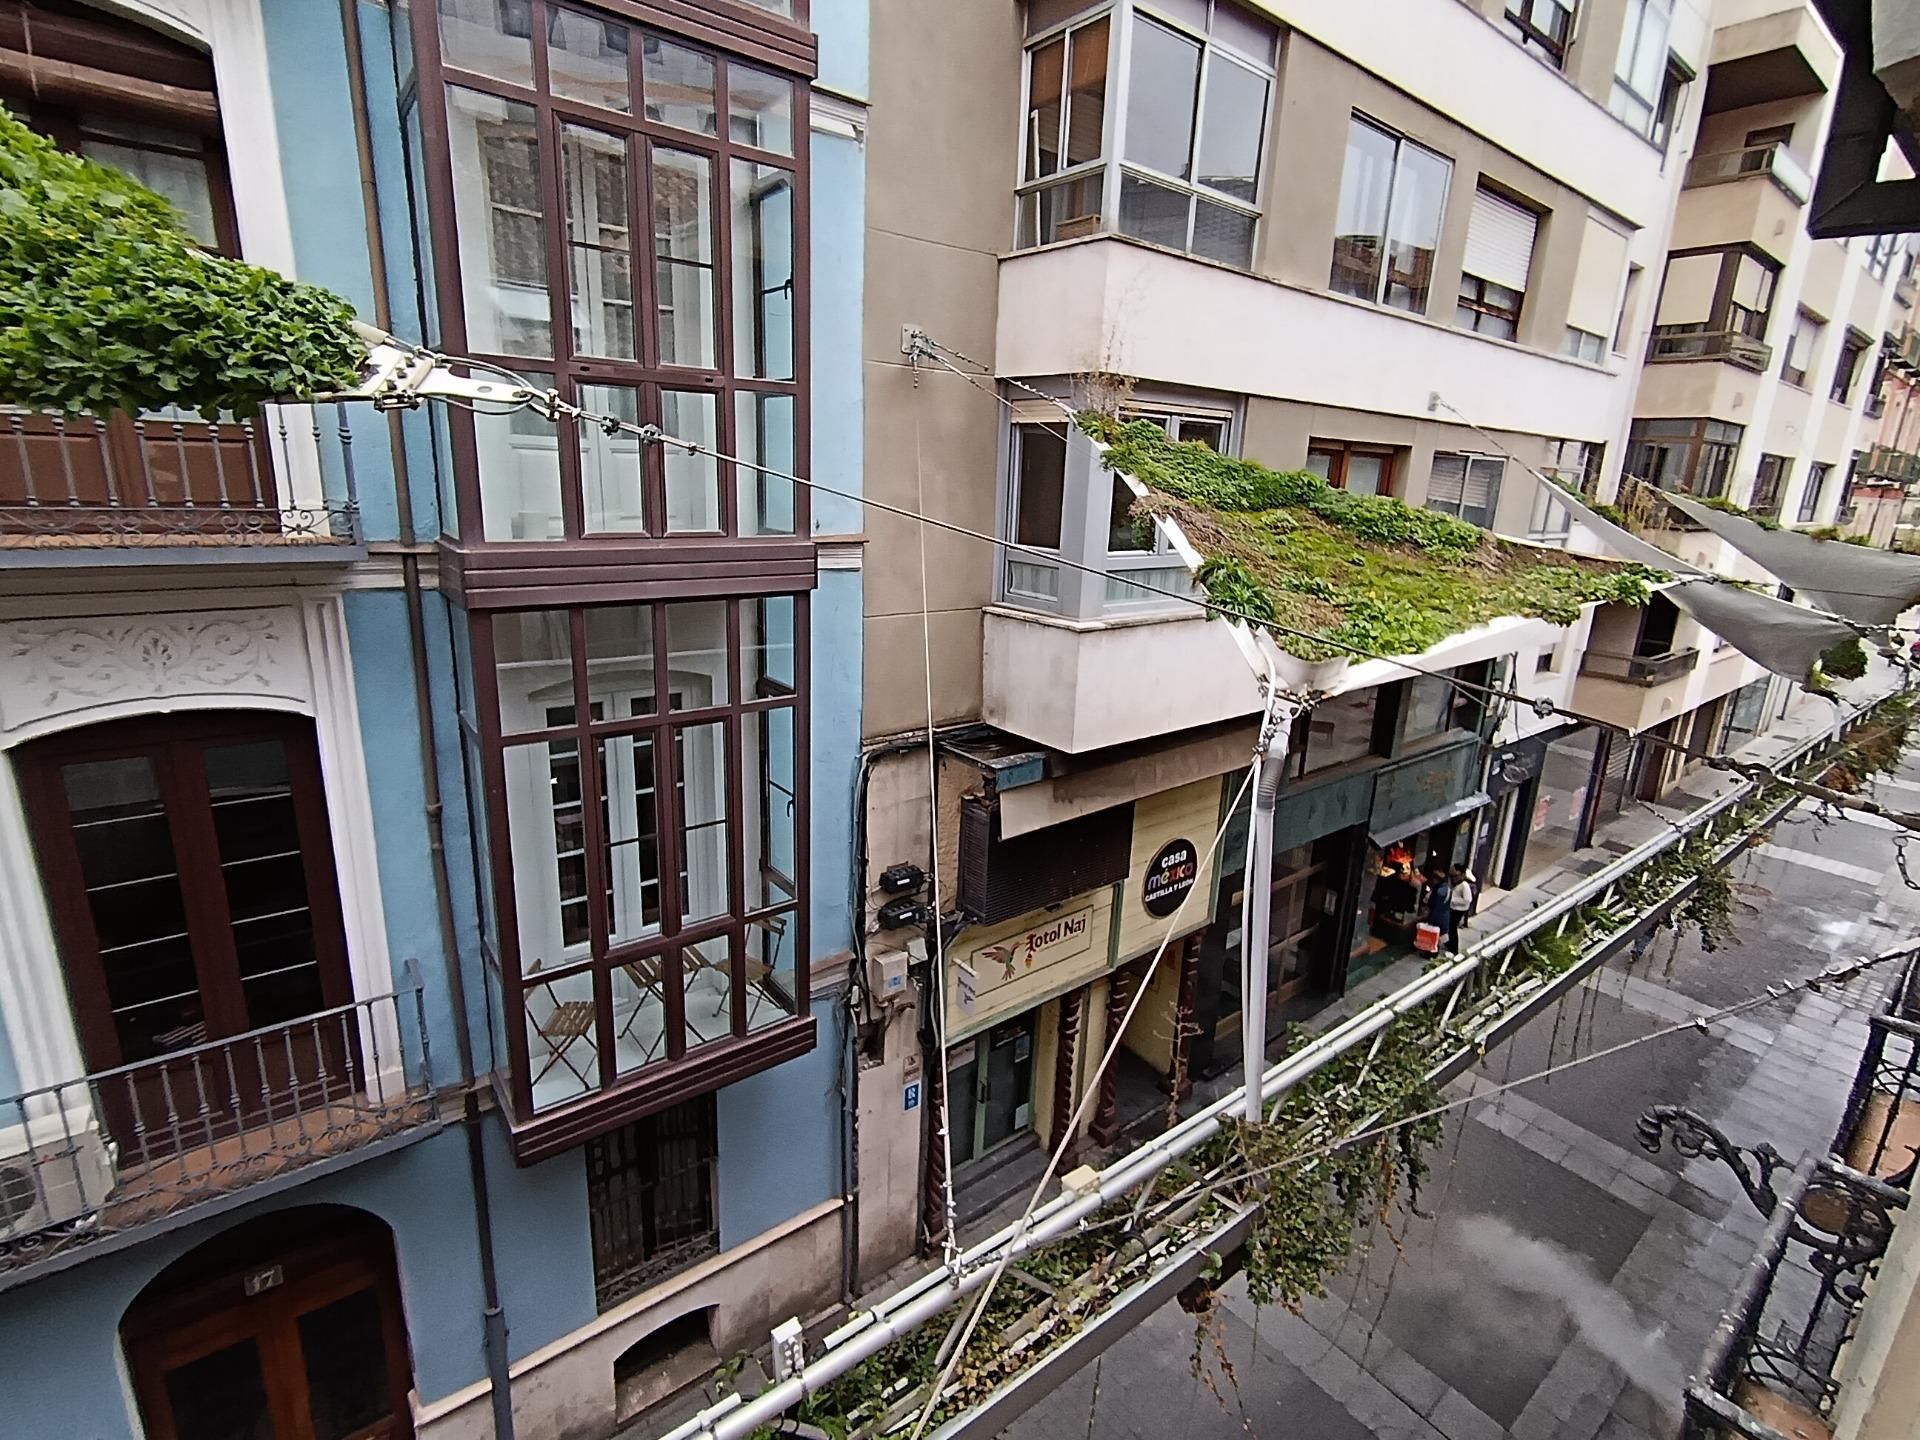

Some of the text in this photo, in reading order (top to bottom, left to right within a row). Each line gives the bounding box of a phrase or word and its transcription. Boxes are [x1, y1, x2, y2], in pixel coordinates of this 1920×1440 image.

[1161, 849, 1187, 868] casa
[1145, 886, 1173, 902] CASTILLA
[1064, 914, 1086, 937] Naj
